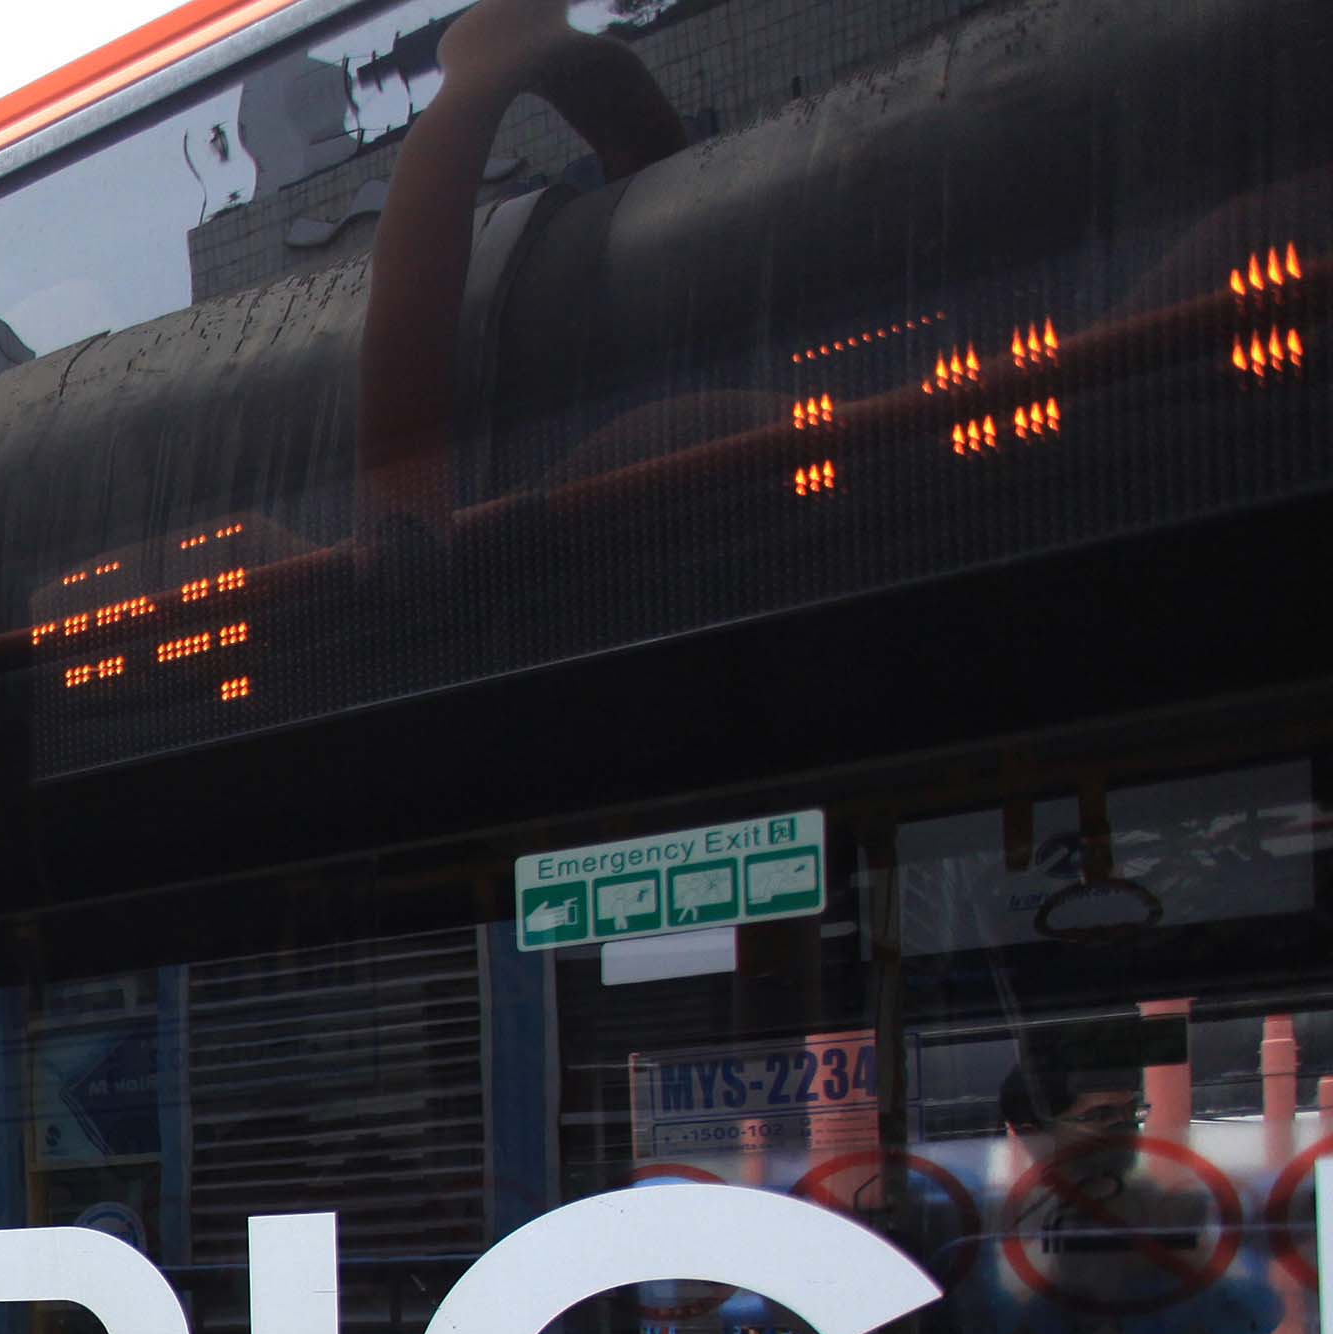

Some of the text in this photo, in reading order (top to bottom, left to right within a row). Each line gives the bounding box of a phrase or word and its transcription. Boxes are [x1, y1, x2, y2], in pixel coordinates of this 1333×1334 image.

[537, 825, 761, 881] Emergency Exit
[660, 1045, 879, 1113] MYS-2234
